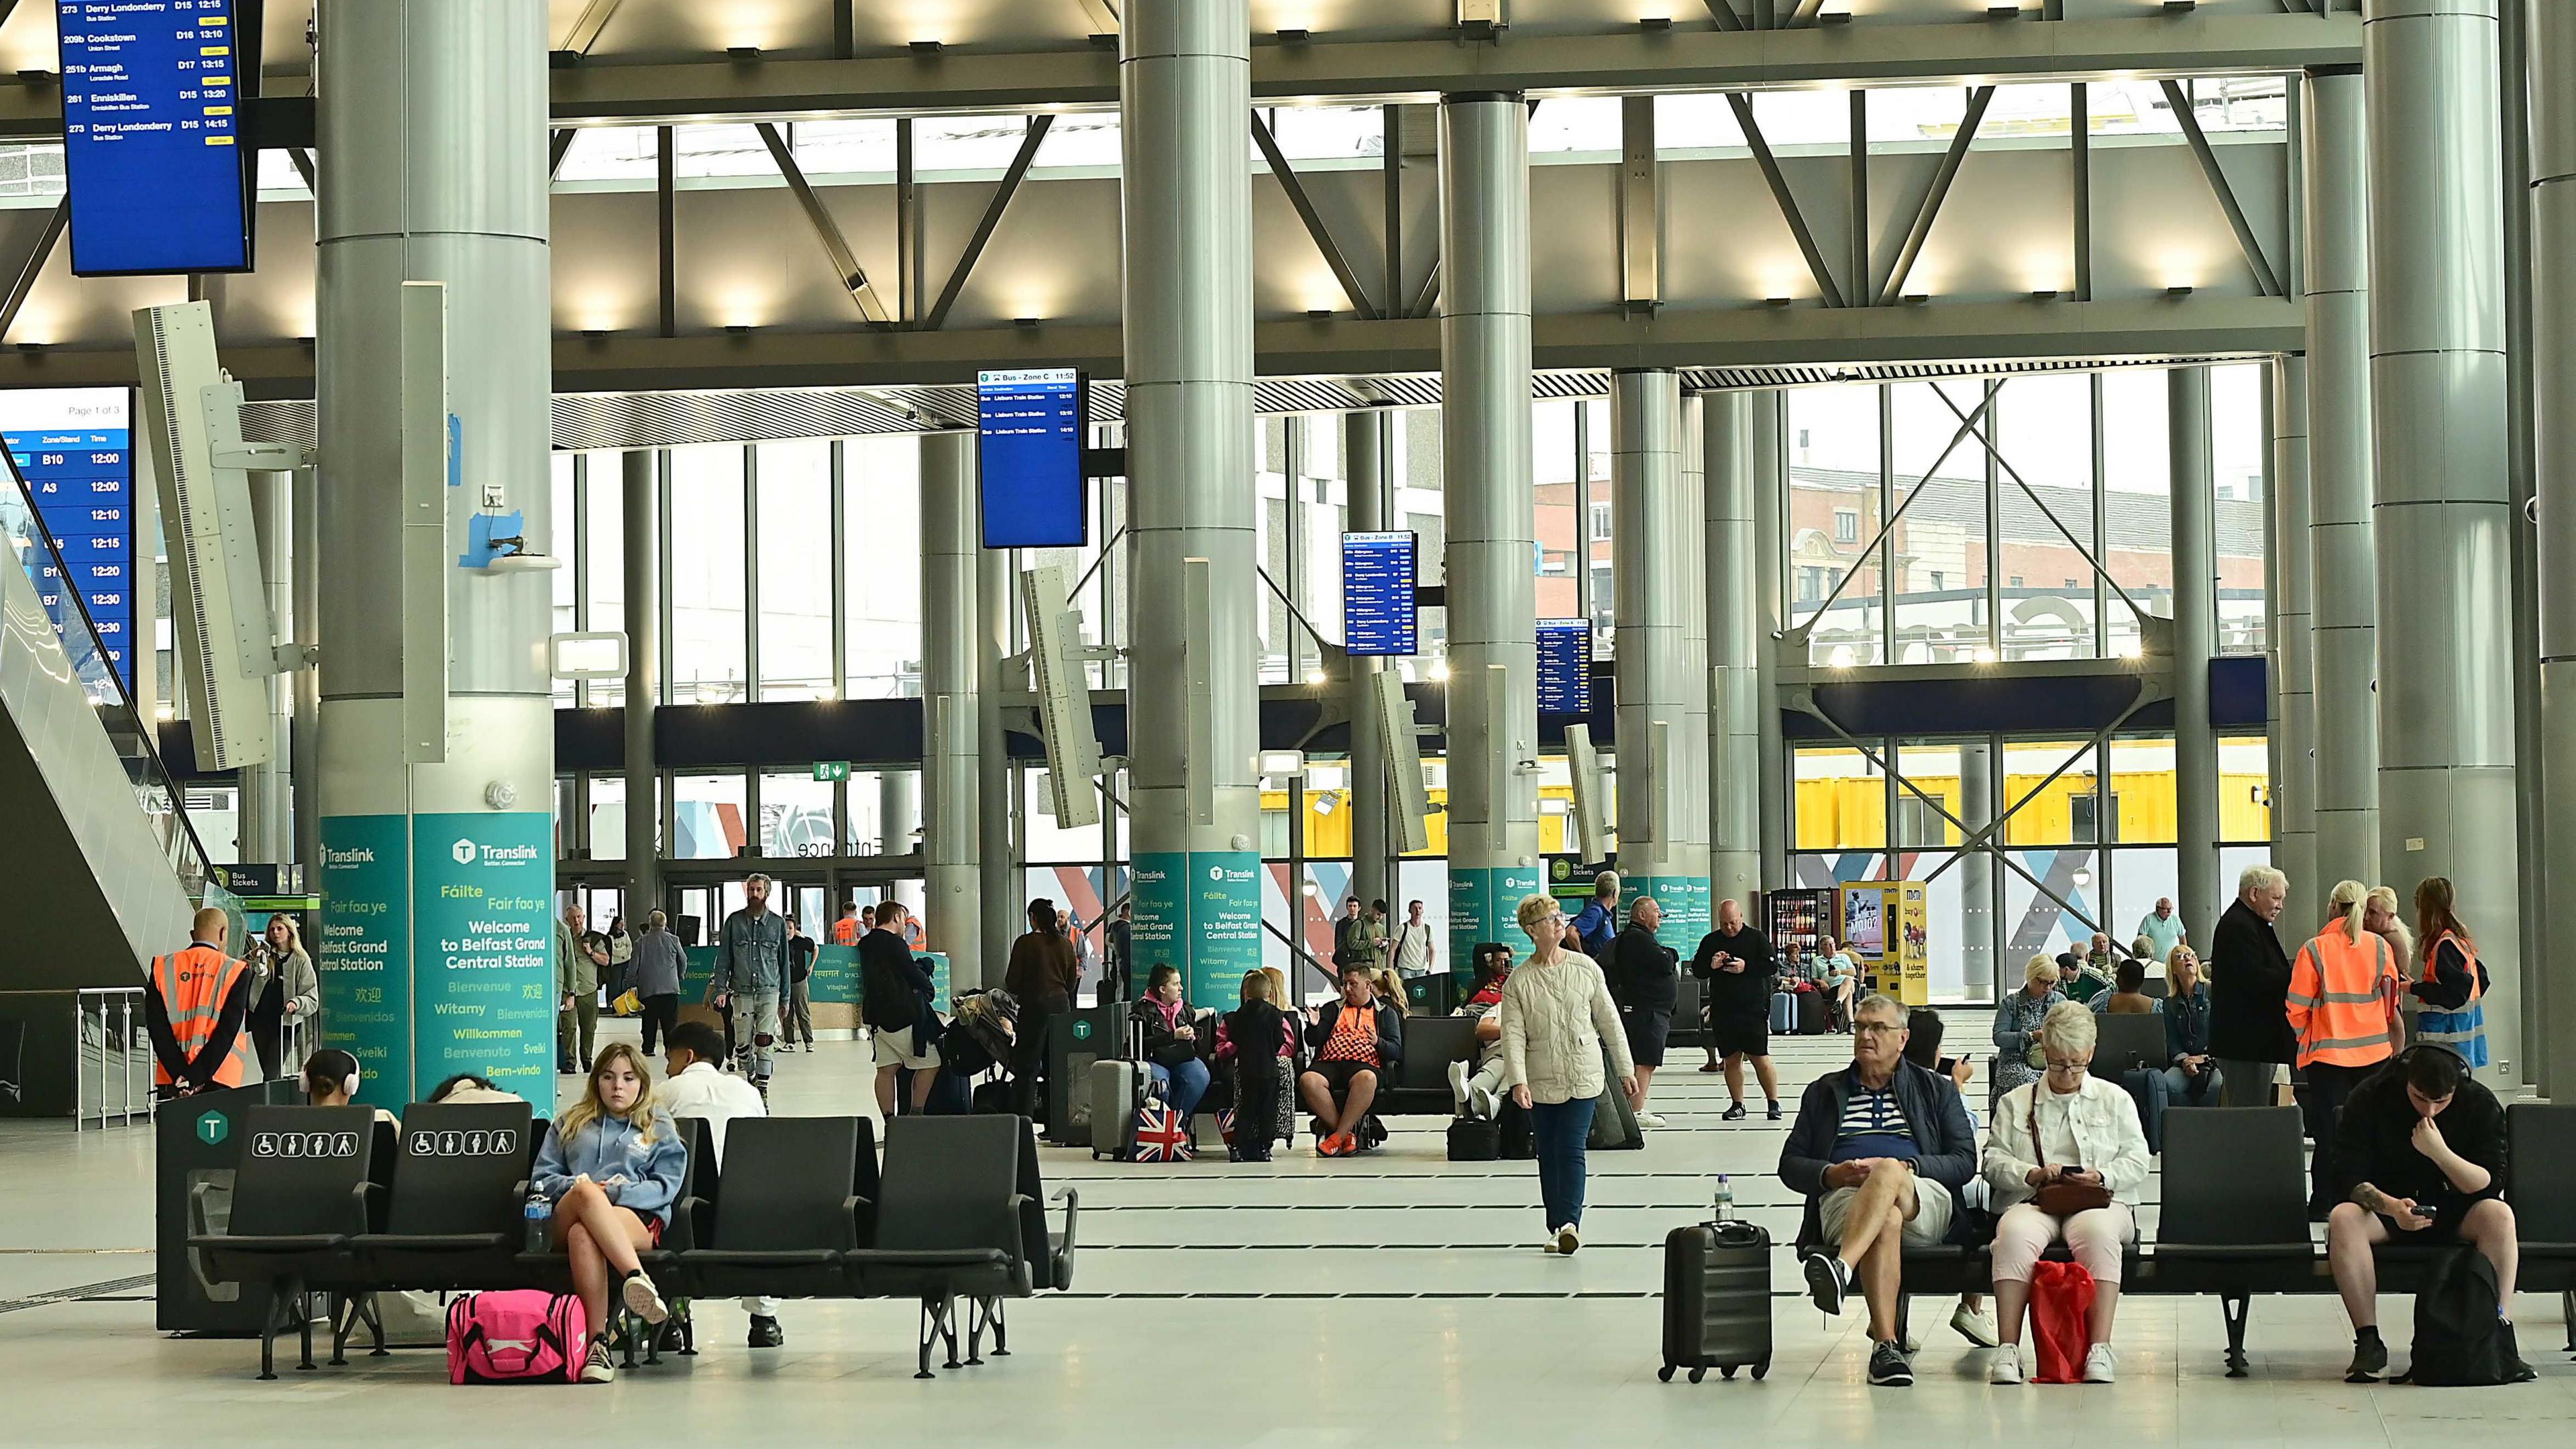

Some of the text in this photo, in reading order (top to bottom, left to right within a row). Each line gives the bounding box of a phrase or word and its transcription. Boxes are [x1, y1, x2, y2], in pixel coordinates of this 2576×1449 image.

[86, 4, 109, 13] Derry
[111, 3, 165, 12] Londonderry
[174, 1, 192, 9] D15
[198, 0, 221, 8] 12:15
[64, 30, 223, 44] 209b Cookstown D16 13:10
[66, 60, 224, 74] 251b Armagh D17 13:15
[68, 90, 225, 103] 261 Enniskillen D15 13:20
[69, 119, 228, 133] 273 Derry Londonderry D15 14:15
[68, 407, 91, 417] Page
[95, 407, 99, 415] 1
[113, 406, 119, 415] 3
[90, 435, 107, 443] Time
[42, 453, 119, 465] B10 12:00
[42, 482, 119, 493] A3 12:00
[91, 510, 119, 520] 12:10
[91, 538, 120, 549] 12:15
[92, 566, 120, 576] 12:20
[44, 594, 120, 605] B7 12:30
[327, 848, 374, 863] Translink
[481, 844, 537, 860] Translink
[1136, 871, 1165, 879] Translink
[1225, 869, 1254, 878] Translink
[232, 878, 258, 887] tickets
[441, 885, 483, 898] Fáilte
[350, 900, 368, 912] faa
[371, 903, 387, 916] ye
[488, 898, 545, 913] Fair faa ye
[1218, 912, 1251, 920] Welcome
[323, 924, 364, 936] Welcome
[468, 920, 530, 934] Welcome
[1150, 922, 1173, 930] Grand
[1215, 921, 1242, 929] Belfast
[1851, 916, 1878, 934] MOJO?
[1206, 932, 1237, 940] Central
[348, 940, 387, 953] Grand
[441, 937, 545, 952] to Belfast Grand
[341, 957, 383, 971] Station
[446, 954, 543, 969] Central Station
[448, 981, 511, 994] Bienvenue
[522, 983, 543, 1000] 欢迎
[355, 987, 382, 1003] 欢迎
[435, 1004, 486, 1017] Witamy
[497, 1008, 549, 1020] Bienvenidos
[453, 1028, 522, 1040] Willkommen
[356, 1046, 387, 1058] Sveiki
[444, 1047, 511, 1059] Benvenuto
[523, 1043, 546, 1055] Sveiki
[486, 1065, 541, 1077] Bem-vindo
